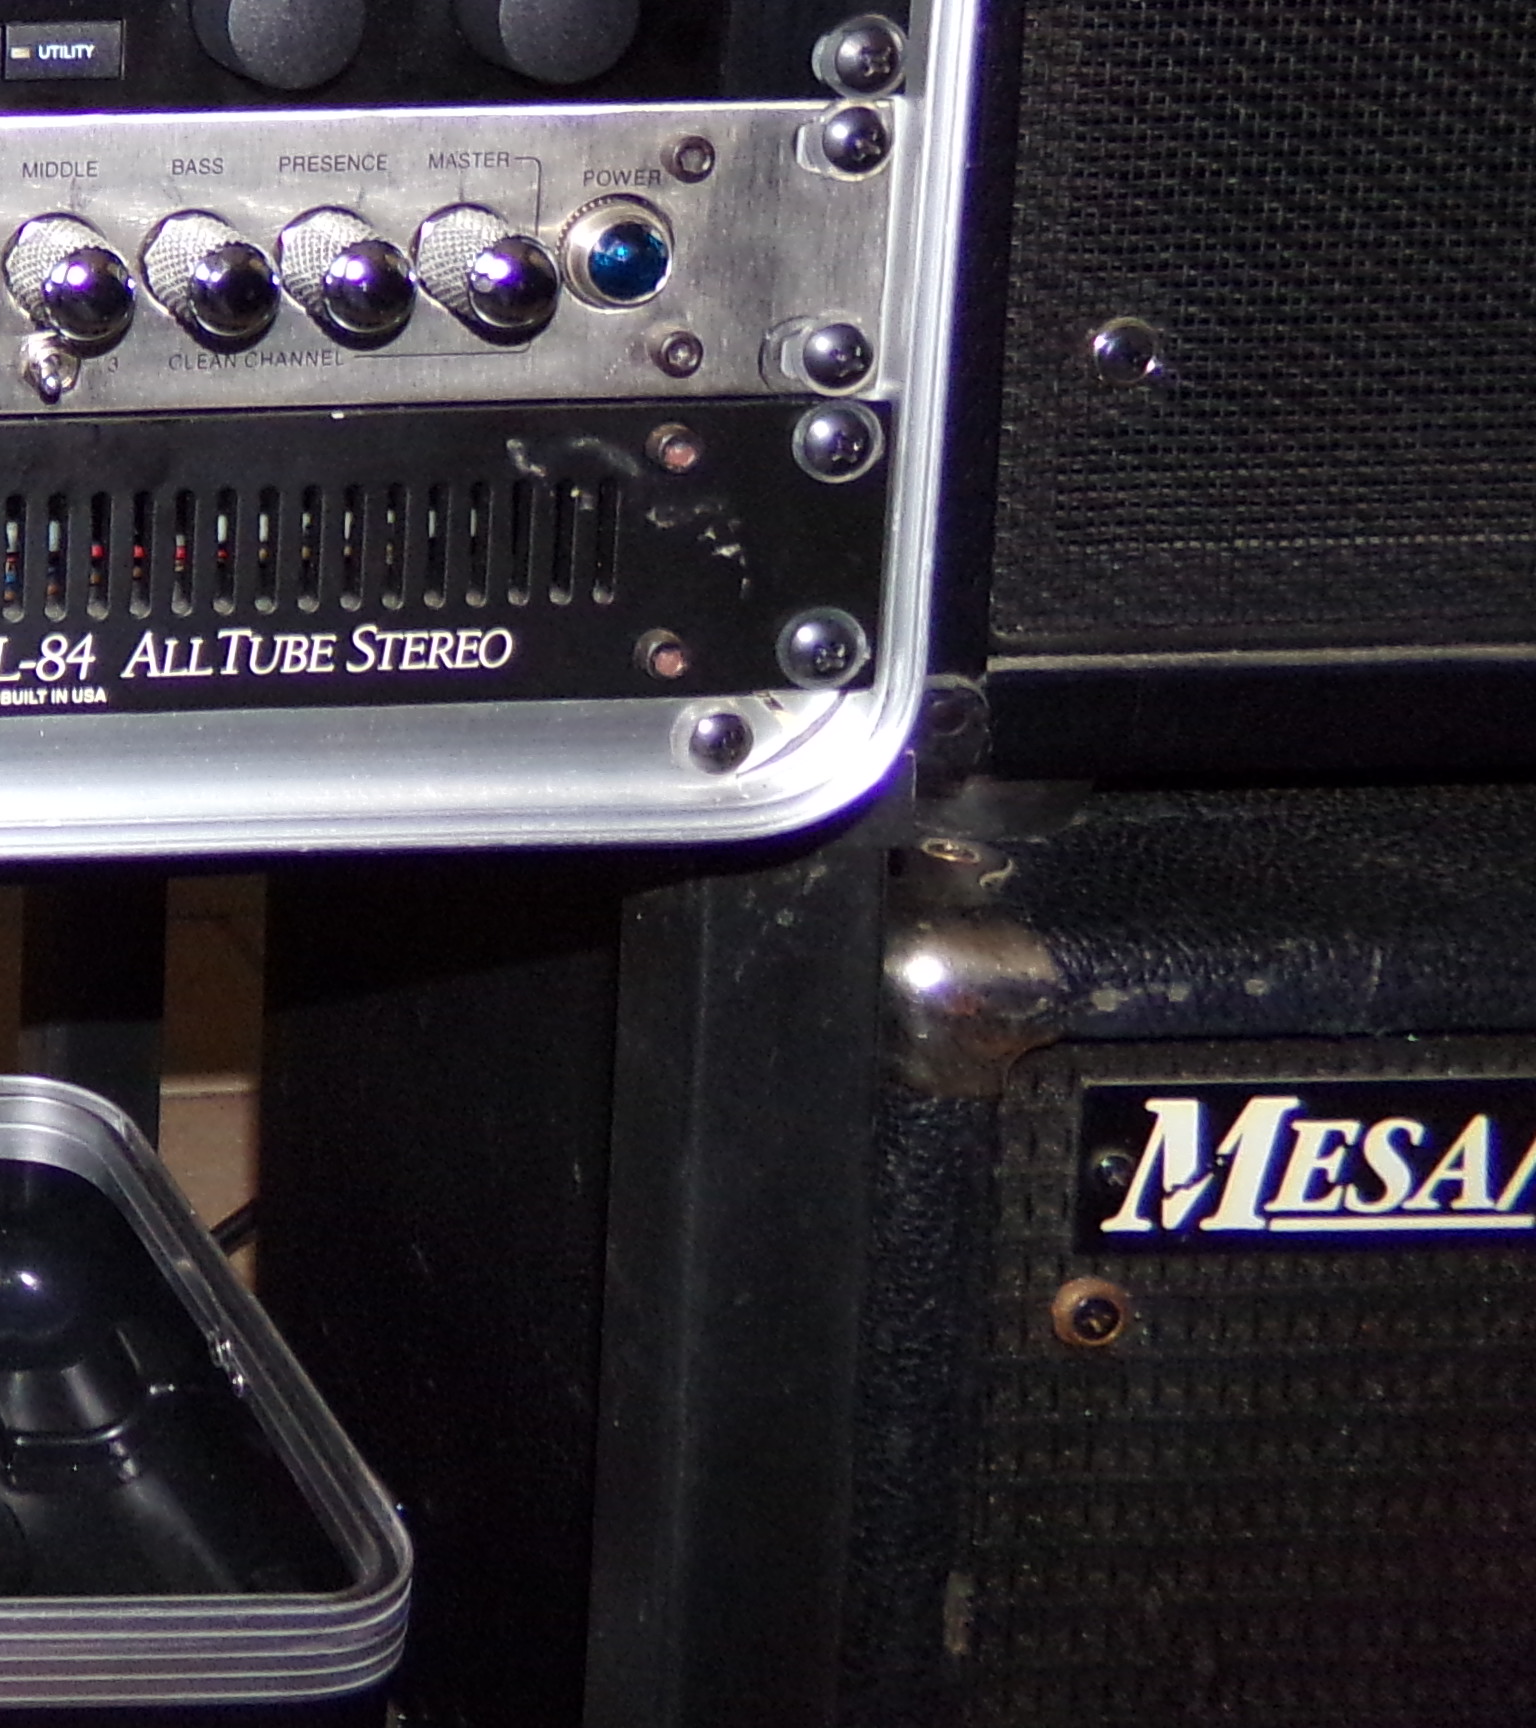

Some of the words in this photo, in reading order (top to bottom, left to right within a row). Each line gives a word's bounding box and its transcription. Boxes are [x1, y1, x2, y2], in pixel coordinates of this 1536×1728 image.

[38, 44, 95, 59] UTILITY
[22, 160, 98, 179] MIDDLE
[171, 158, 224, 175] BASS
[278, 154, 387, 173] PRESENCE
[427, 151, 510, 170] MASTER
[583, 169, 662, 187] POWER
[168, 351, 237, 372] CLEAN
[244, 348, 345, 368] CHANNEL
[218, 627, 336, 675] TUBE
[346, 624, 513, 674] STEREO
[50, 688, 69, 705] IN
[72, 686, 107, 705] USA
